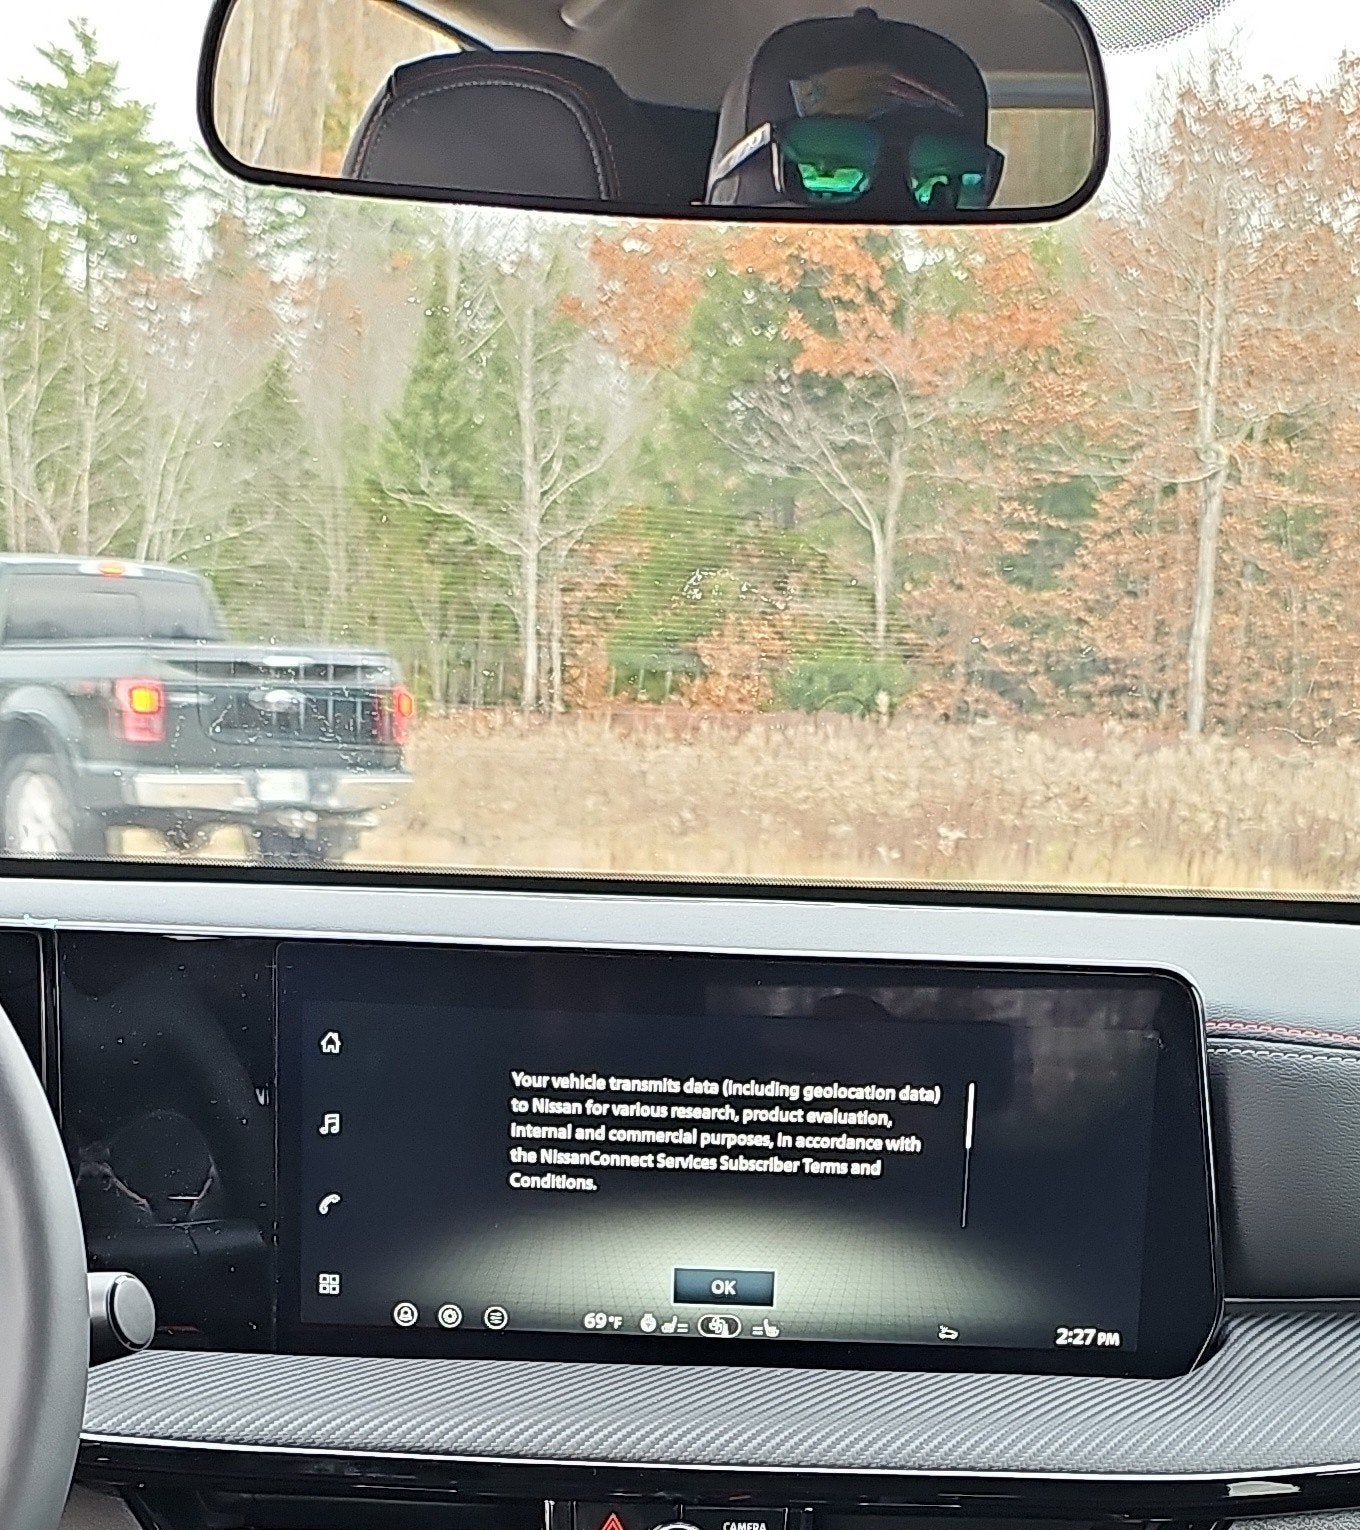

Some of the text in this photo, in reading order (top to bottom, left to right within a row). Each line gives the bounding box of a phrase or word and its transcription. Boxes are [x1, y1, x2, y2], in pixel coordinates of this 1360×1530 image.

[511, 1072, 941, 1104] Your vehicle transmits data (including geolocation data)
[511, 1098, 893, 1128] to Nissan for various research, product evaluation,
[511, 1123, 922, 1152] internal and commercial purposes, in accordance with
[510, 1147, 882, 1176] the NissanConnect Services Subscriber Terms and
[509, 1172, 597, 1191] Conditions.
[711, 1280, 736, 1296] OK
[583, 1312, 623, 1330] 69°F
[1056, 1327, 1120, 1346] 2:27 PM
